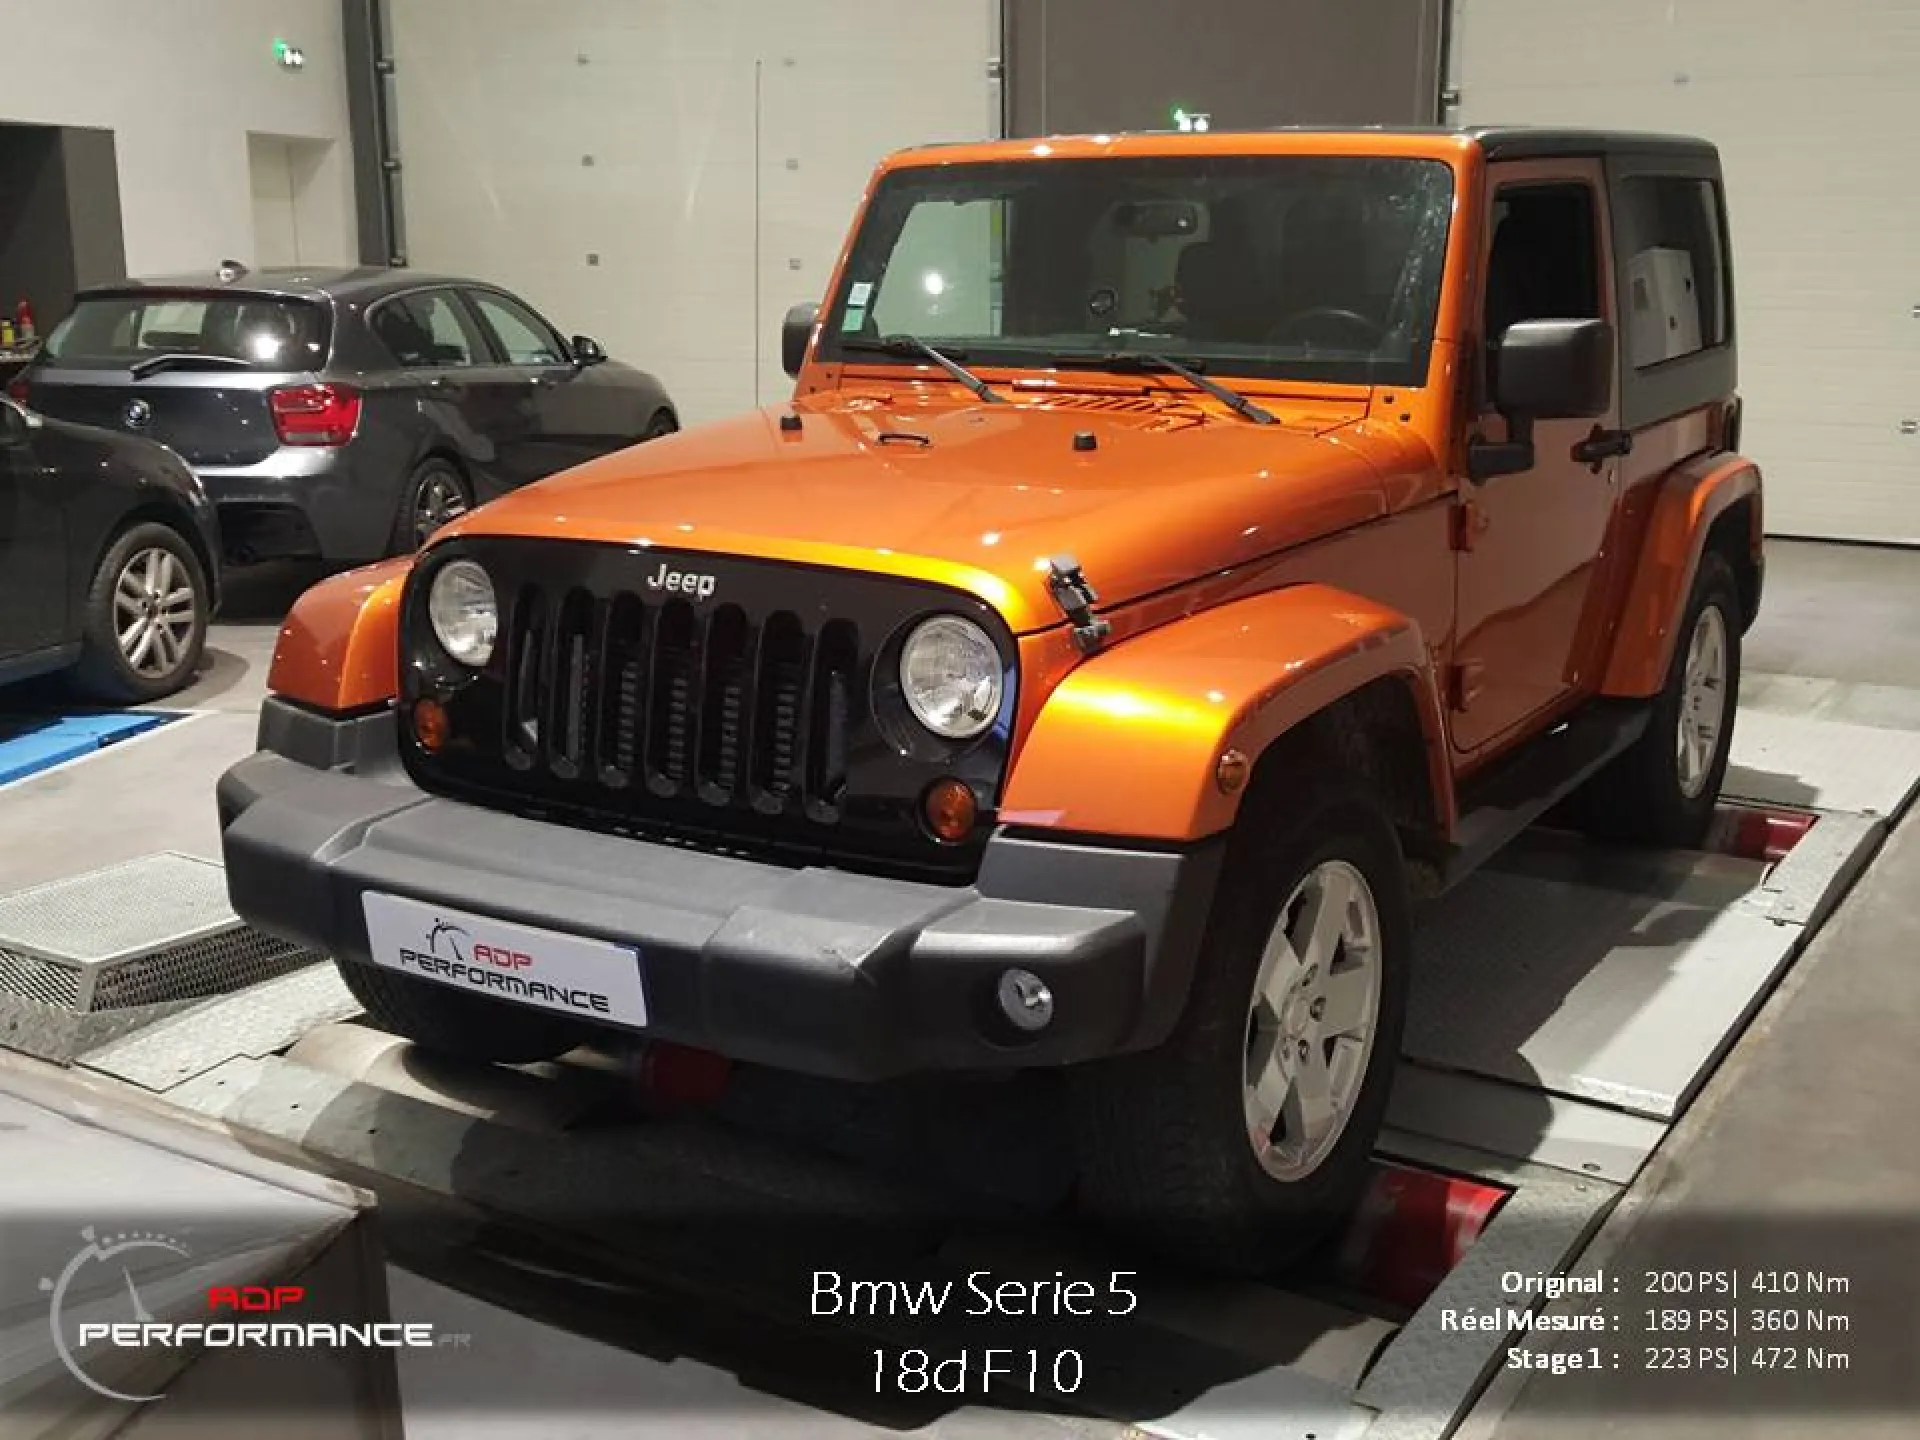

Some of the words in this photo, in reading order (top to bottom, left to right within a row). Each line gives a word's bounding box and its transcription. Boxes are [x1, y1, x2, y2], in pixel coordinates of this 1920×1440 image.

[647, 563, 715, 602] Jeep
[473, 944, 532, 970] ADP
[400, 948, 610, 1013] PERFORMANCE
